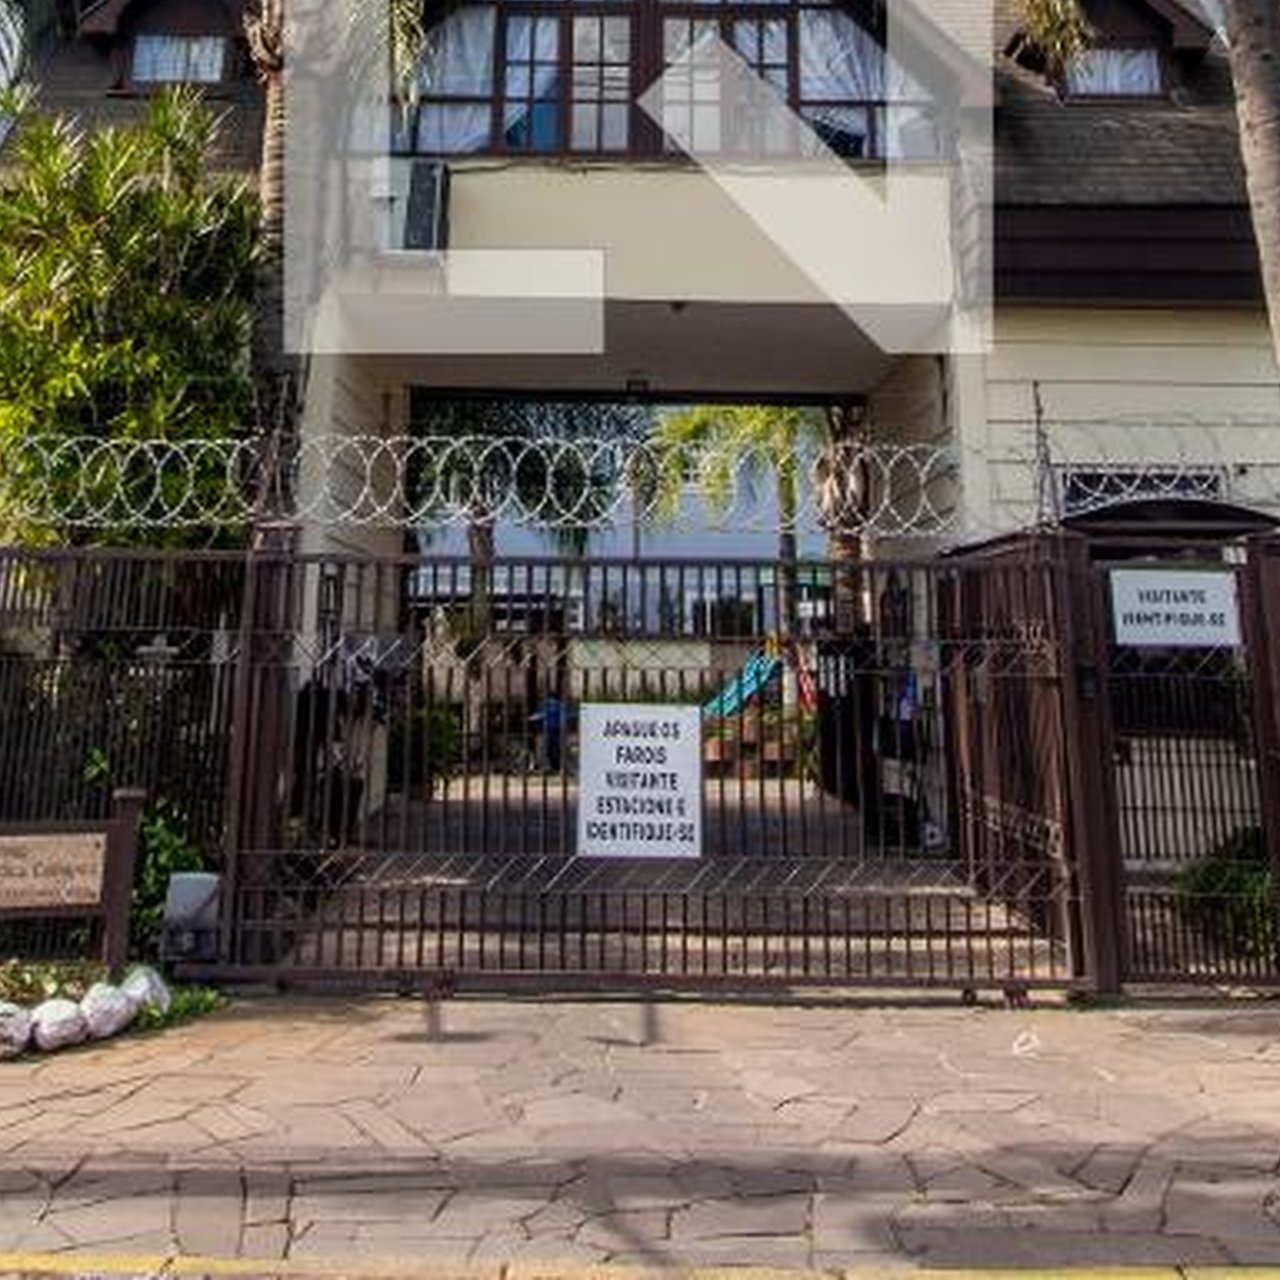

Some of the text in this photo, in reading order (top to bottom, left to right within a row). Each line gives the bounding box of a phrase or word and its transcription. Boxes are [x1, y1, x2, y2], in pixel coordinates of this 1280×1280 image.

[1137, 589, 1206, 604] VISITANTE
[605, 772, 678, 791] VISITANTE
[597, 795, 672, 815] ESTACIONE
